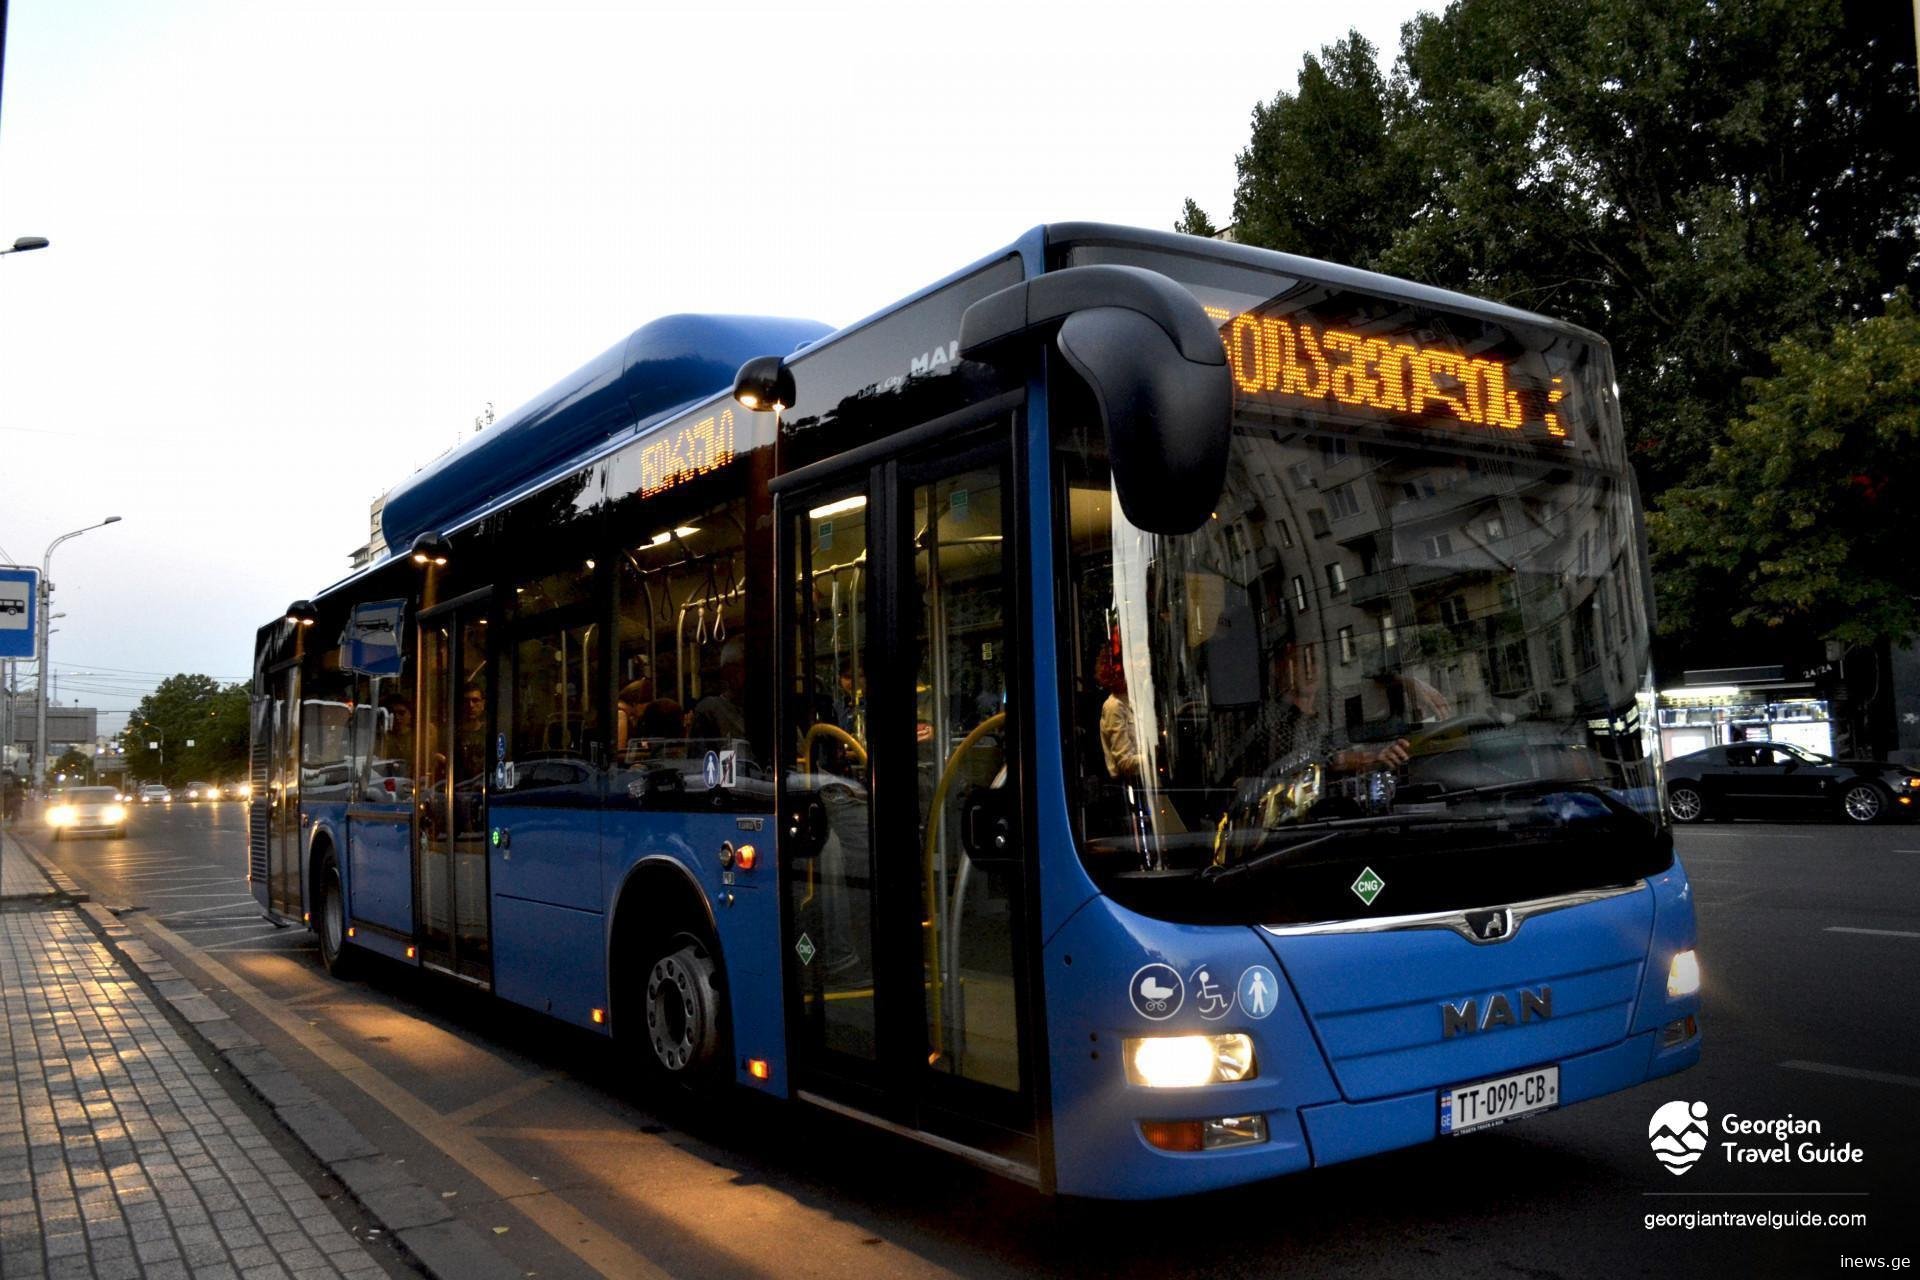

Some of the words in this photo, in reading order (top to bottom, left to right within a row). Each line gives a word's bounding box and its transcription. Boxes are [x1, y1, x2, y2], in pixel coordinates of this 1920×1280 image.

[1358, 880, 1378, 892] CNG
[1440, 985, 1552, 1038] MAN
[1457, 1075, 1546, 1123] TT-099-CB
[1441, 1114, 1451, 1126] GE
